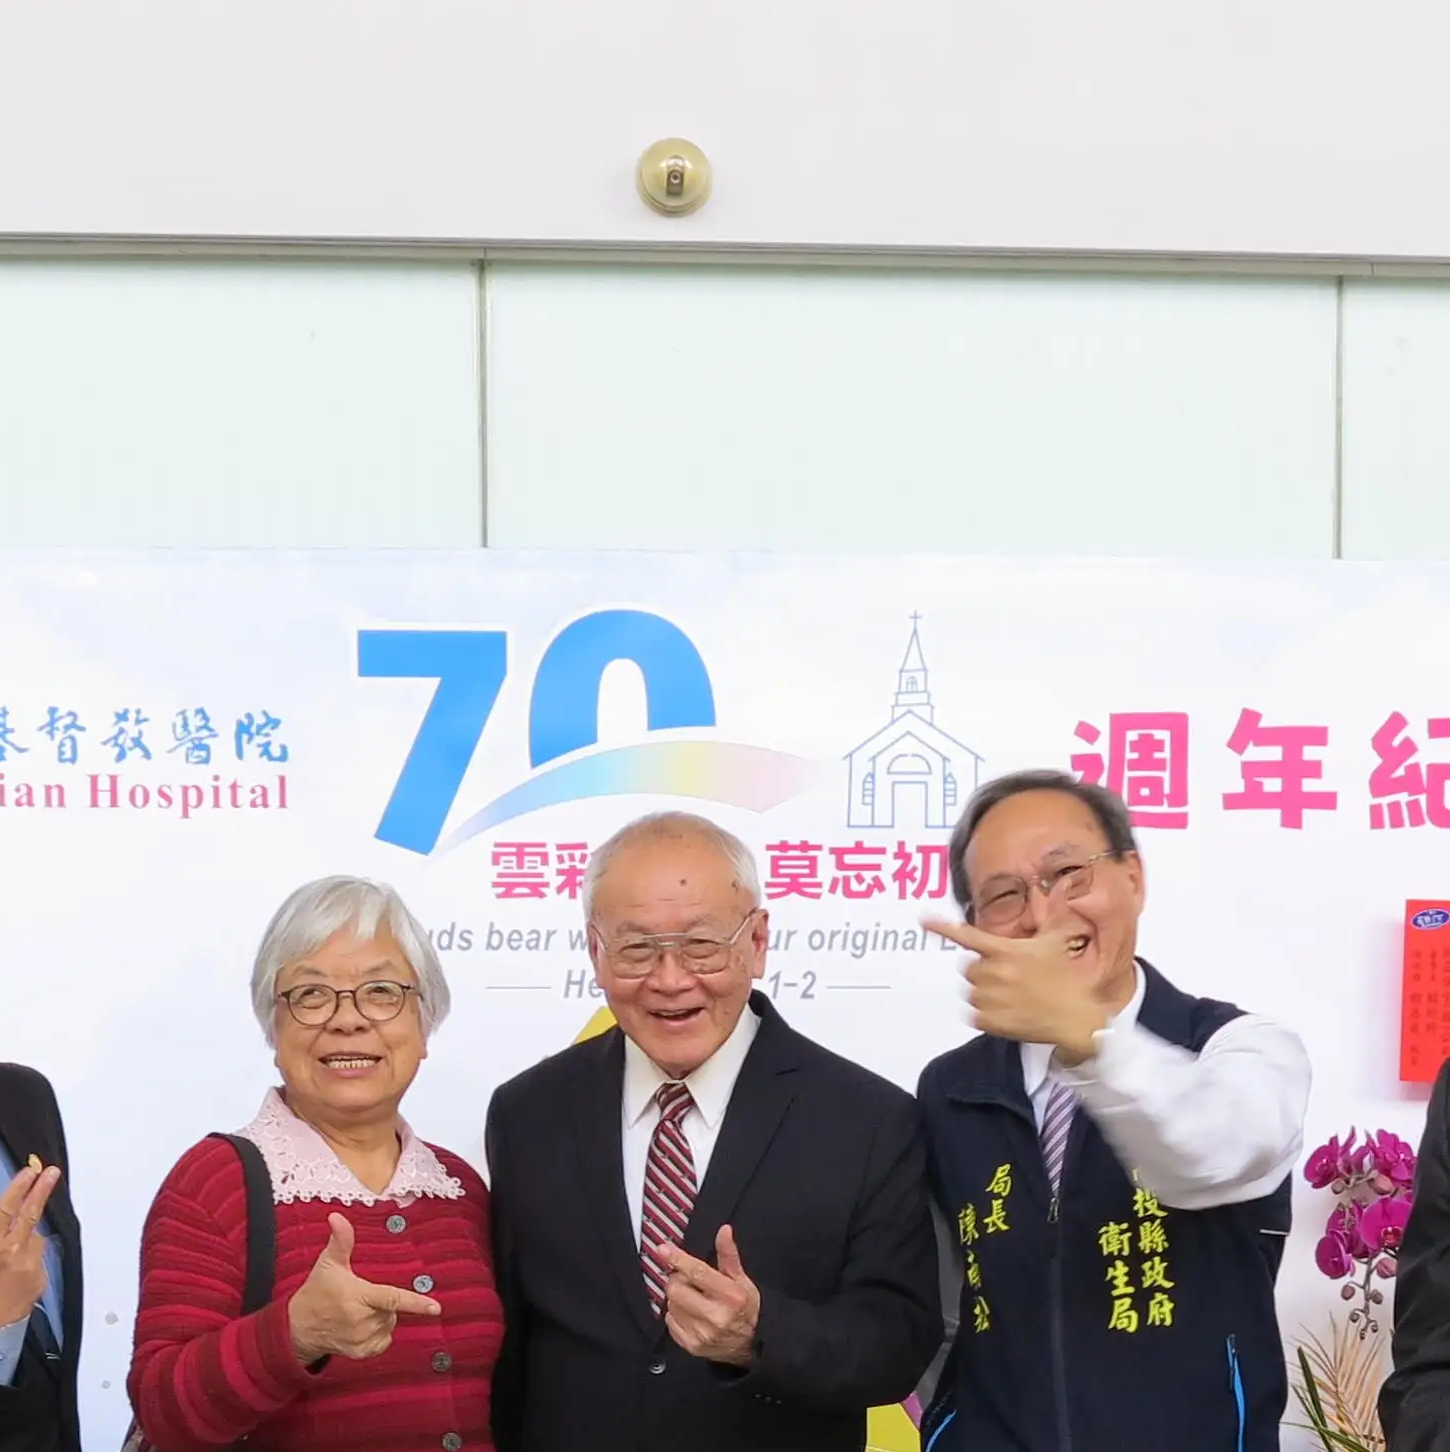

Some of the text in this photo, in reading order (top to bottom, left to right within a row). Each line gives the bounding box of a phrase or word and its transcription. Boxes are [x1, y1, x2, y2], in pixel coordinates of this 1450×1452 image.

[357, 608, 717, 856] 70
[87, 774, 289, 818] Hospital
[765, 840, 949, 900] 莫忘初
[485, 921, 558, 951] bear
[766, 929, 799, 951] ur
[807, 921, 929, 959] original
[983, 1162, 1013, 1235] 局長
[1099, 1221, 1139, 1334] 衛生局
[1132, 1186, 1176, 1328] 投縣政府
